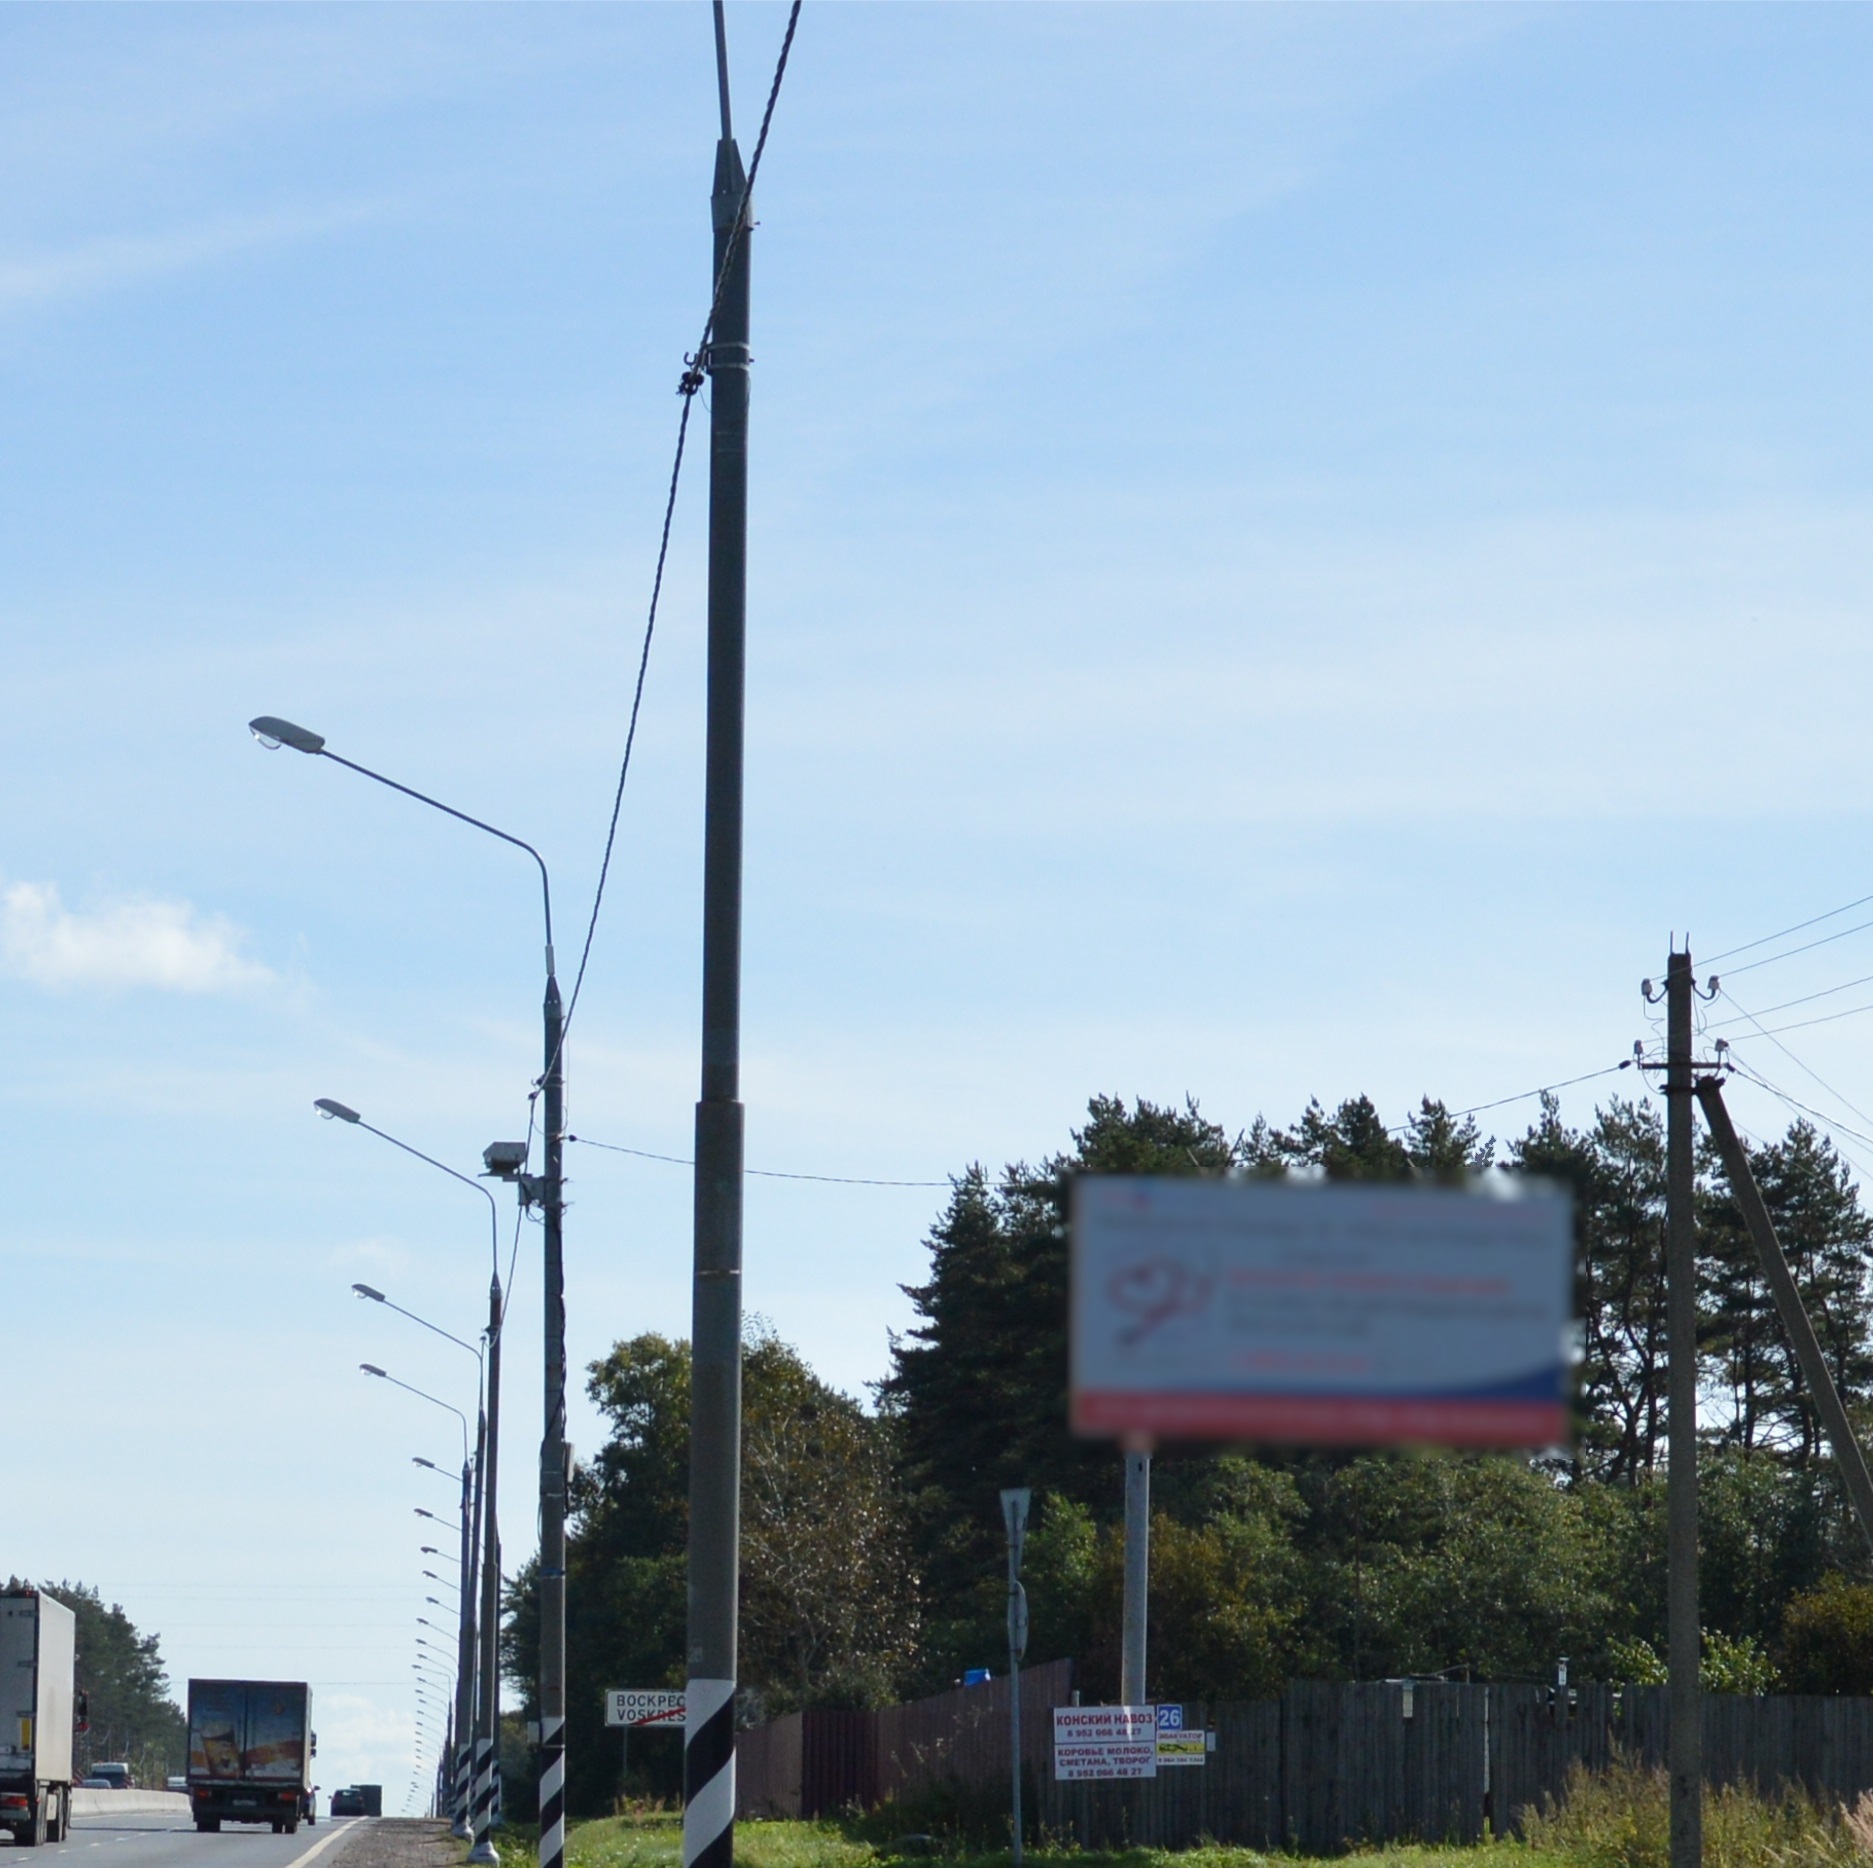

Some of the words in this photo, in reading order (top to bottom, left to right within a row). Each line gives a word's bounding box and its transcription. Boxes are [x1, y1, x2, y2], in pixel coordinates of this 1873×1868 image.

[1056, 1712, 1111, 1726] КОНСКИЙ
[1114, 1713, 1153, 1724] НАВОЗ
[1159, 1709, 1180, 1726] 26
[1057, 1748, 1105, 1756] КОРОВЬЕ
[1112, 1756, 1151, 1764] ТВОРОГ
